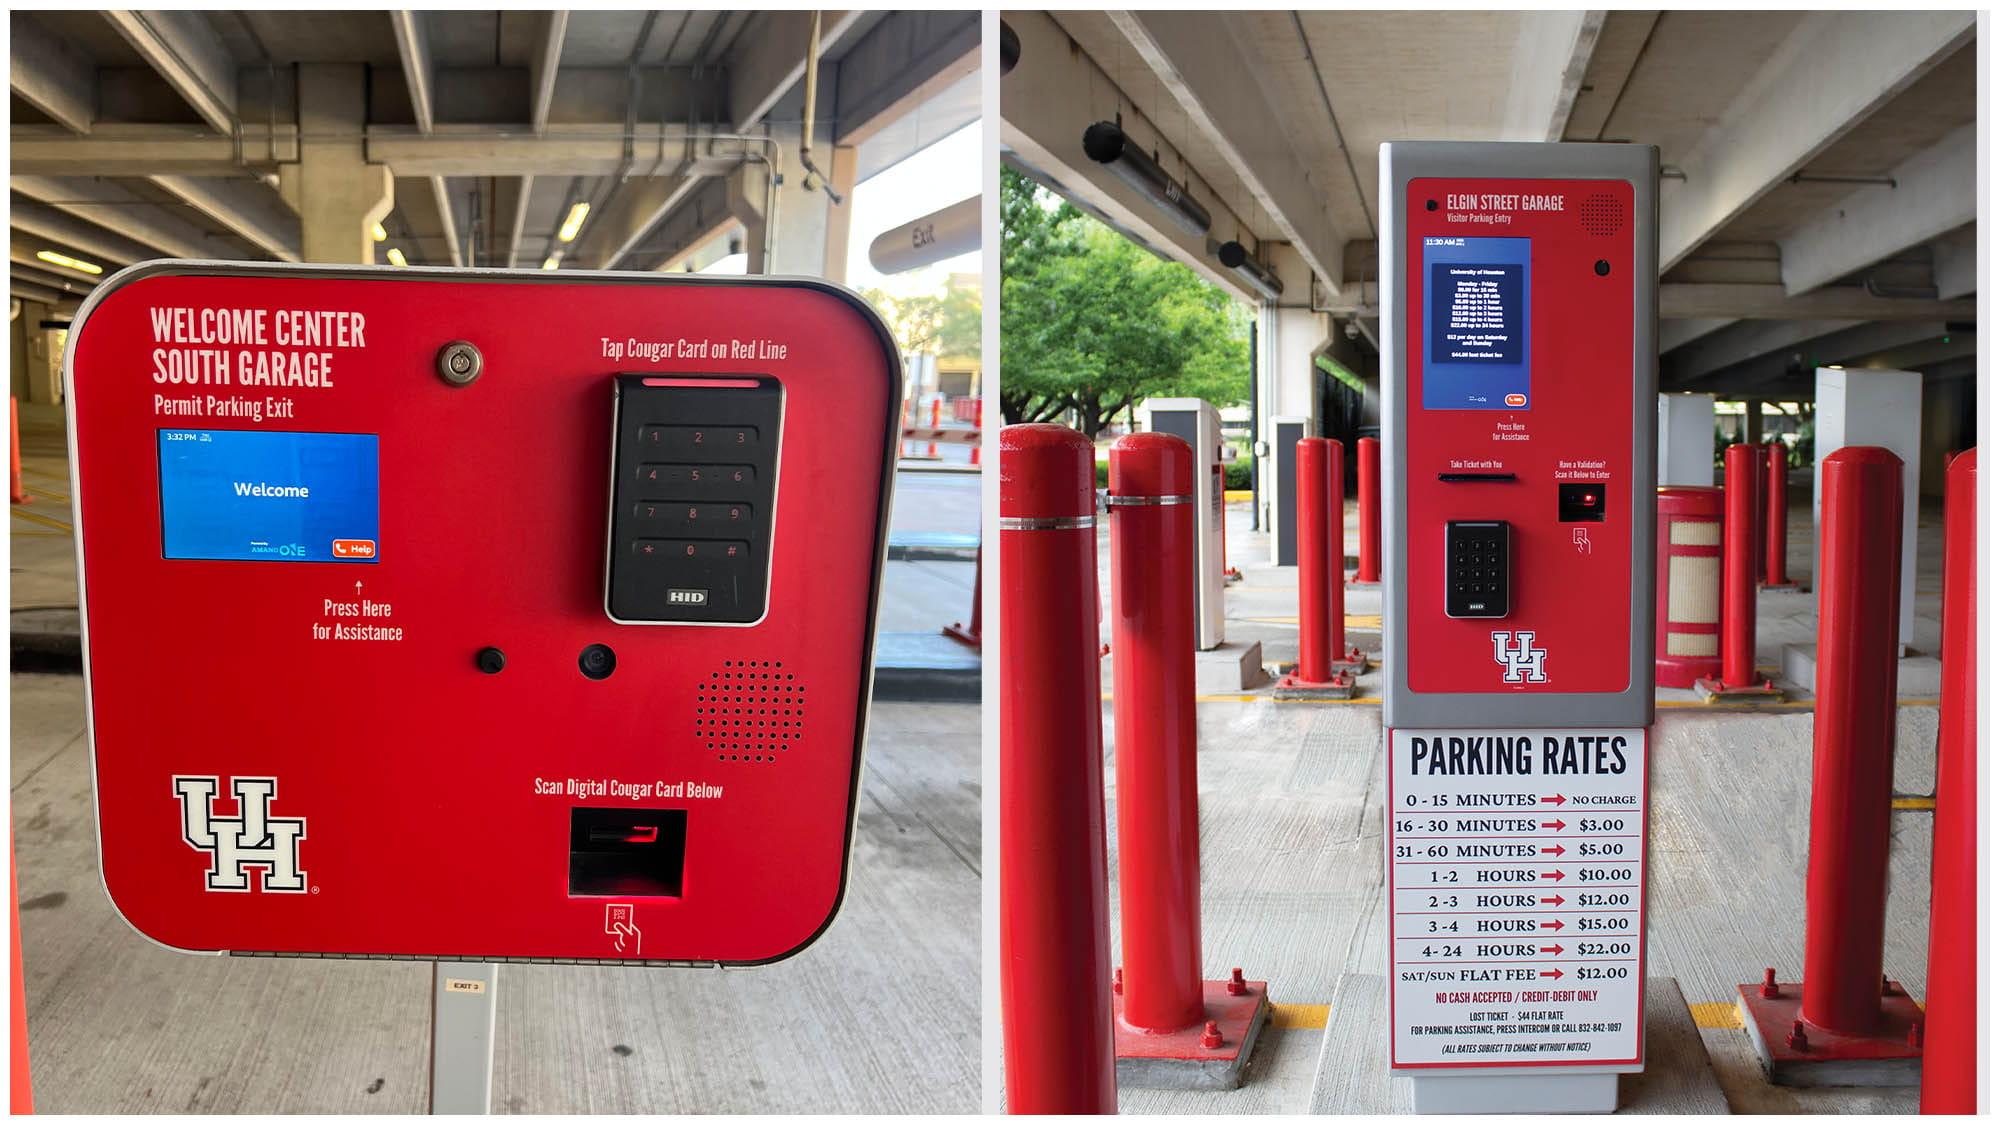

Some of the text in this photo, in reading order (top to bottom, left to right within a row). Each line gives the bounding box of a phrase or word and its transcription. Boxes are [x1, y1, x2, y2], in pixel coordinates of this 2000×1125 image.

[1447, 194, 1564, 212] ELGIN STREET GARAGE
[1447, 213, 1511, 225] Visitor Parking Entry
[912, 222, 935, 248] Exit
[150, 307, 366, 347] WELCOME CENTER
[601, 338, 787, 362] Tap Cougar Card on Red Line
[153, 348, 334, 388] SOUTH GARAGE
[154, 394, 294, 422] Permit Parking Exit
[1497, 423, 1525, 431] Press Here
[652, 431, 745, 443] 1 2 3
[1493, 433, 1530, 441] for Assistance
[1451, 460, 1463, 468] Take
[1464, 460, 1480, 468] Ticket
[650, 470, 742, 482] 4 5 6
[1596, 471, 1610, 479] Enter
[233, 482, 309, 498] Welcome
[648, 507, 739, 519] 7 8 9
[351, 545, 372, 555] Help
[670, 591, 705, 603] HID
[324, 599, 391, 617] Press Here
[313, 622, 403, 641] for Assistance
[1492, 631, 1546, 683] UH
[1411, 736, 1627, 775] PARKING RATES
[535, 778, 723, 800] Scan Digital Cougar Card Below
[1433, 795, 1448, 806] 15
[1456, 794, 1536, 806] MINUTES
[1572, 796, 1589, 804] NO
[1591, 796, 1636, 805] CHARGE
[1396, 820, 1413, 832] 16
[1428, 820, 1448, 832] 30
[1456, 819, 1536, 832] MINUTES
[1579, 819, 1624, 832] $3.00
[171, 774, 308, 894] UH
[1396, 846, 1413, 858] 31
[1428, 846, 1448, 858] 60
[1456, 845, 1536, 857] MINUTES
[1579, 843, 1624, 856] $5.00
[1477, 870, 1536, 883] HOURS
[1579, 869, 1632, 882] $10.00
[1477, 895, 1536, 908] HOURS
[1578, 894, 1630, 907] $12.00
[1477, 920, 1536, 932] HOURS
[1578, 918, 1629, 931] $15.00
[1443, 945, 1462, 957] 24
[1477, 944, 1536, 957] HOURS
[1577, 943, 1631, 955] $22.00
[1401, 967, 1628, 982] SAT/SUN FLAT FEE $12.00
[1436, 991, 1598, 1003] NO CASH ACCEPTED / CREDIT-DEBIT ONLY
[1470, 1012, 1485, 1021] LOST
[1487, 1012, 1508, 1021] TICKET
[1518, 1011, 1530, 1020] $44
[1531, 1011, 1546, 1020] FLAT
[1548, 1011, 1564, 1020] RATE
[1411, 1023, 1622, 1035] FOR PARKING ASSISTANCE, PRESS INTERCOM OR CALL 832-842-1097
[1442, 1042, 1591, 1055] (ALL RATES SUBJECT TO CHANGE WITHOUT NOTICE)
